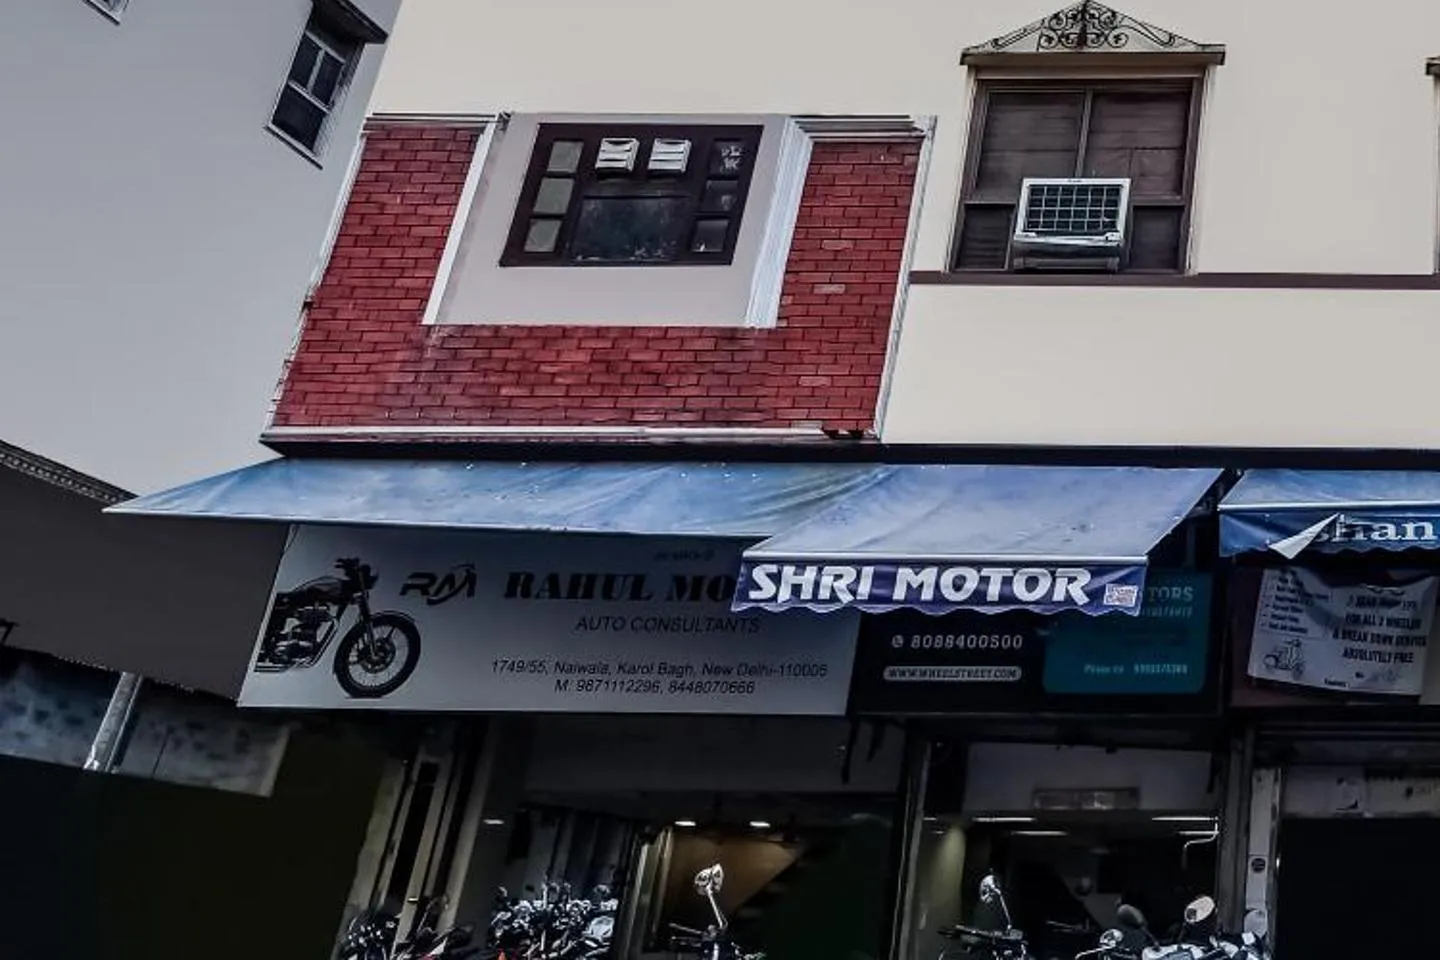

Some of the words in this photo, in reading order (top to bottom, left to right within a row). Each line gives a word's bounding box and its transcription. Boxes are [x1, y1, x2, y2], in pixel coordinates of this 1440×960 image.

[503, 571, 654, 602] RAHUL
[748, 563, 875, 605] SHRI
[890, 566, 1092, 607] MOTOR
[575, 616, 626, 633] AUTO
[630, 617, 761, 634] CONSULTANTS
[911, 634, 1024, 650] 8088400500
[617, 662, 654, 676] Karol
[657, 662, 697, 679] Bagh,
[702, 663, 733, 677] New
